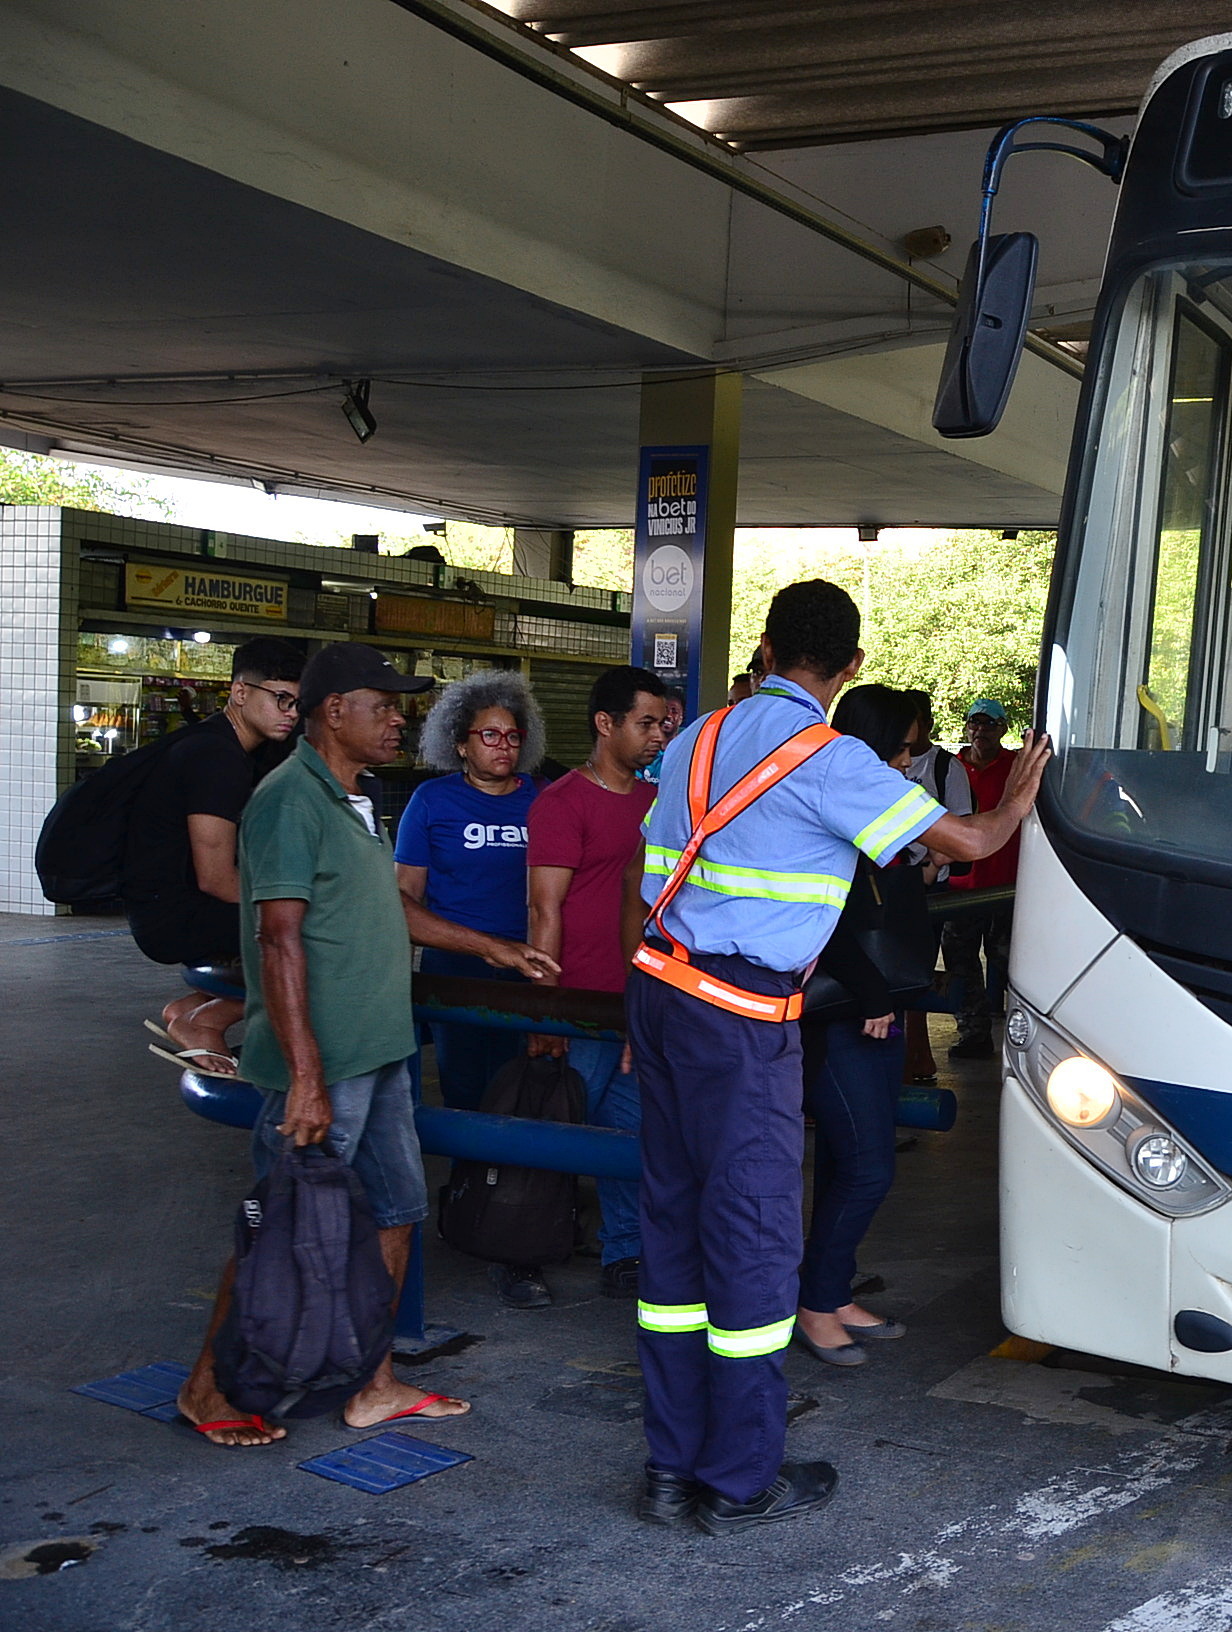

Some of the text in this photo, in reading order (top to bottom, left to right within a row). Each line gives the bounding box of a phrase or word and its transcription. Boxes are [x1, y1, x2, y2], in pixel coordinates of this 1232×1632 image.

[648, 497, 696, 518] NA bet DO
[648, 516, 696, 536] VINICIUS JR
[651, 560, 687, 585] bet
[184, 576, 283, 604] HAMBURGUE
[650, 588, 686, 597] nacional
[184, 597, 227, 610] CACHORRO
[230, 604, 260, 614] QUENTE
